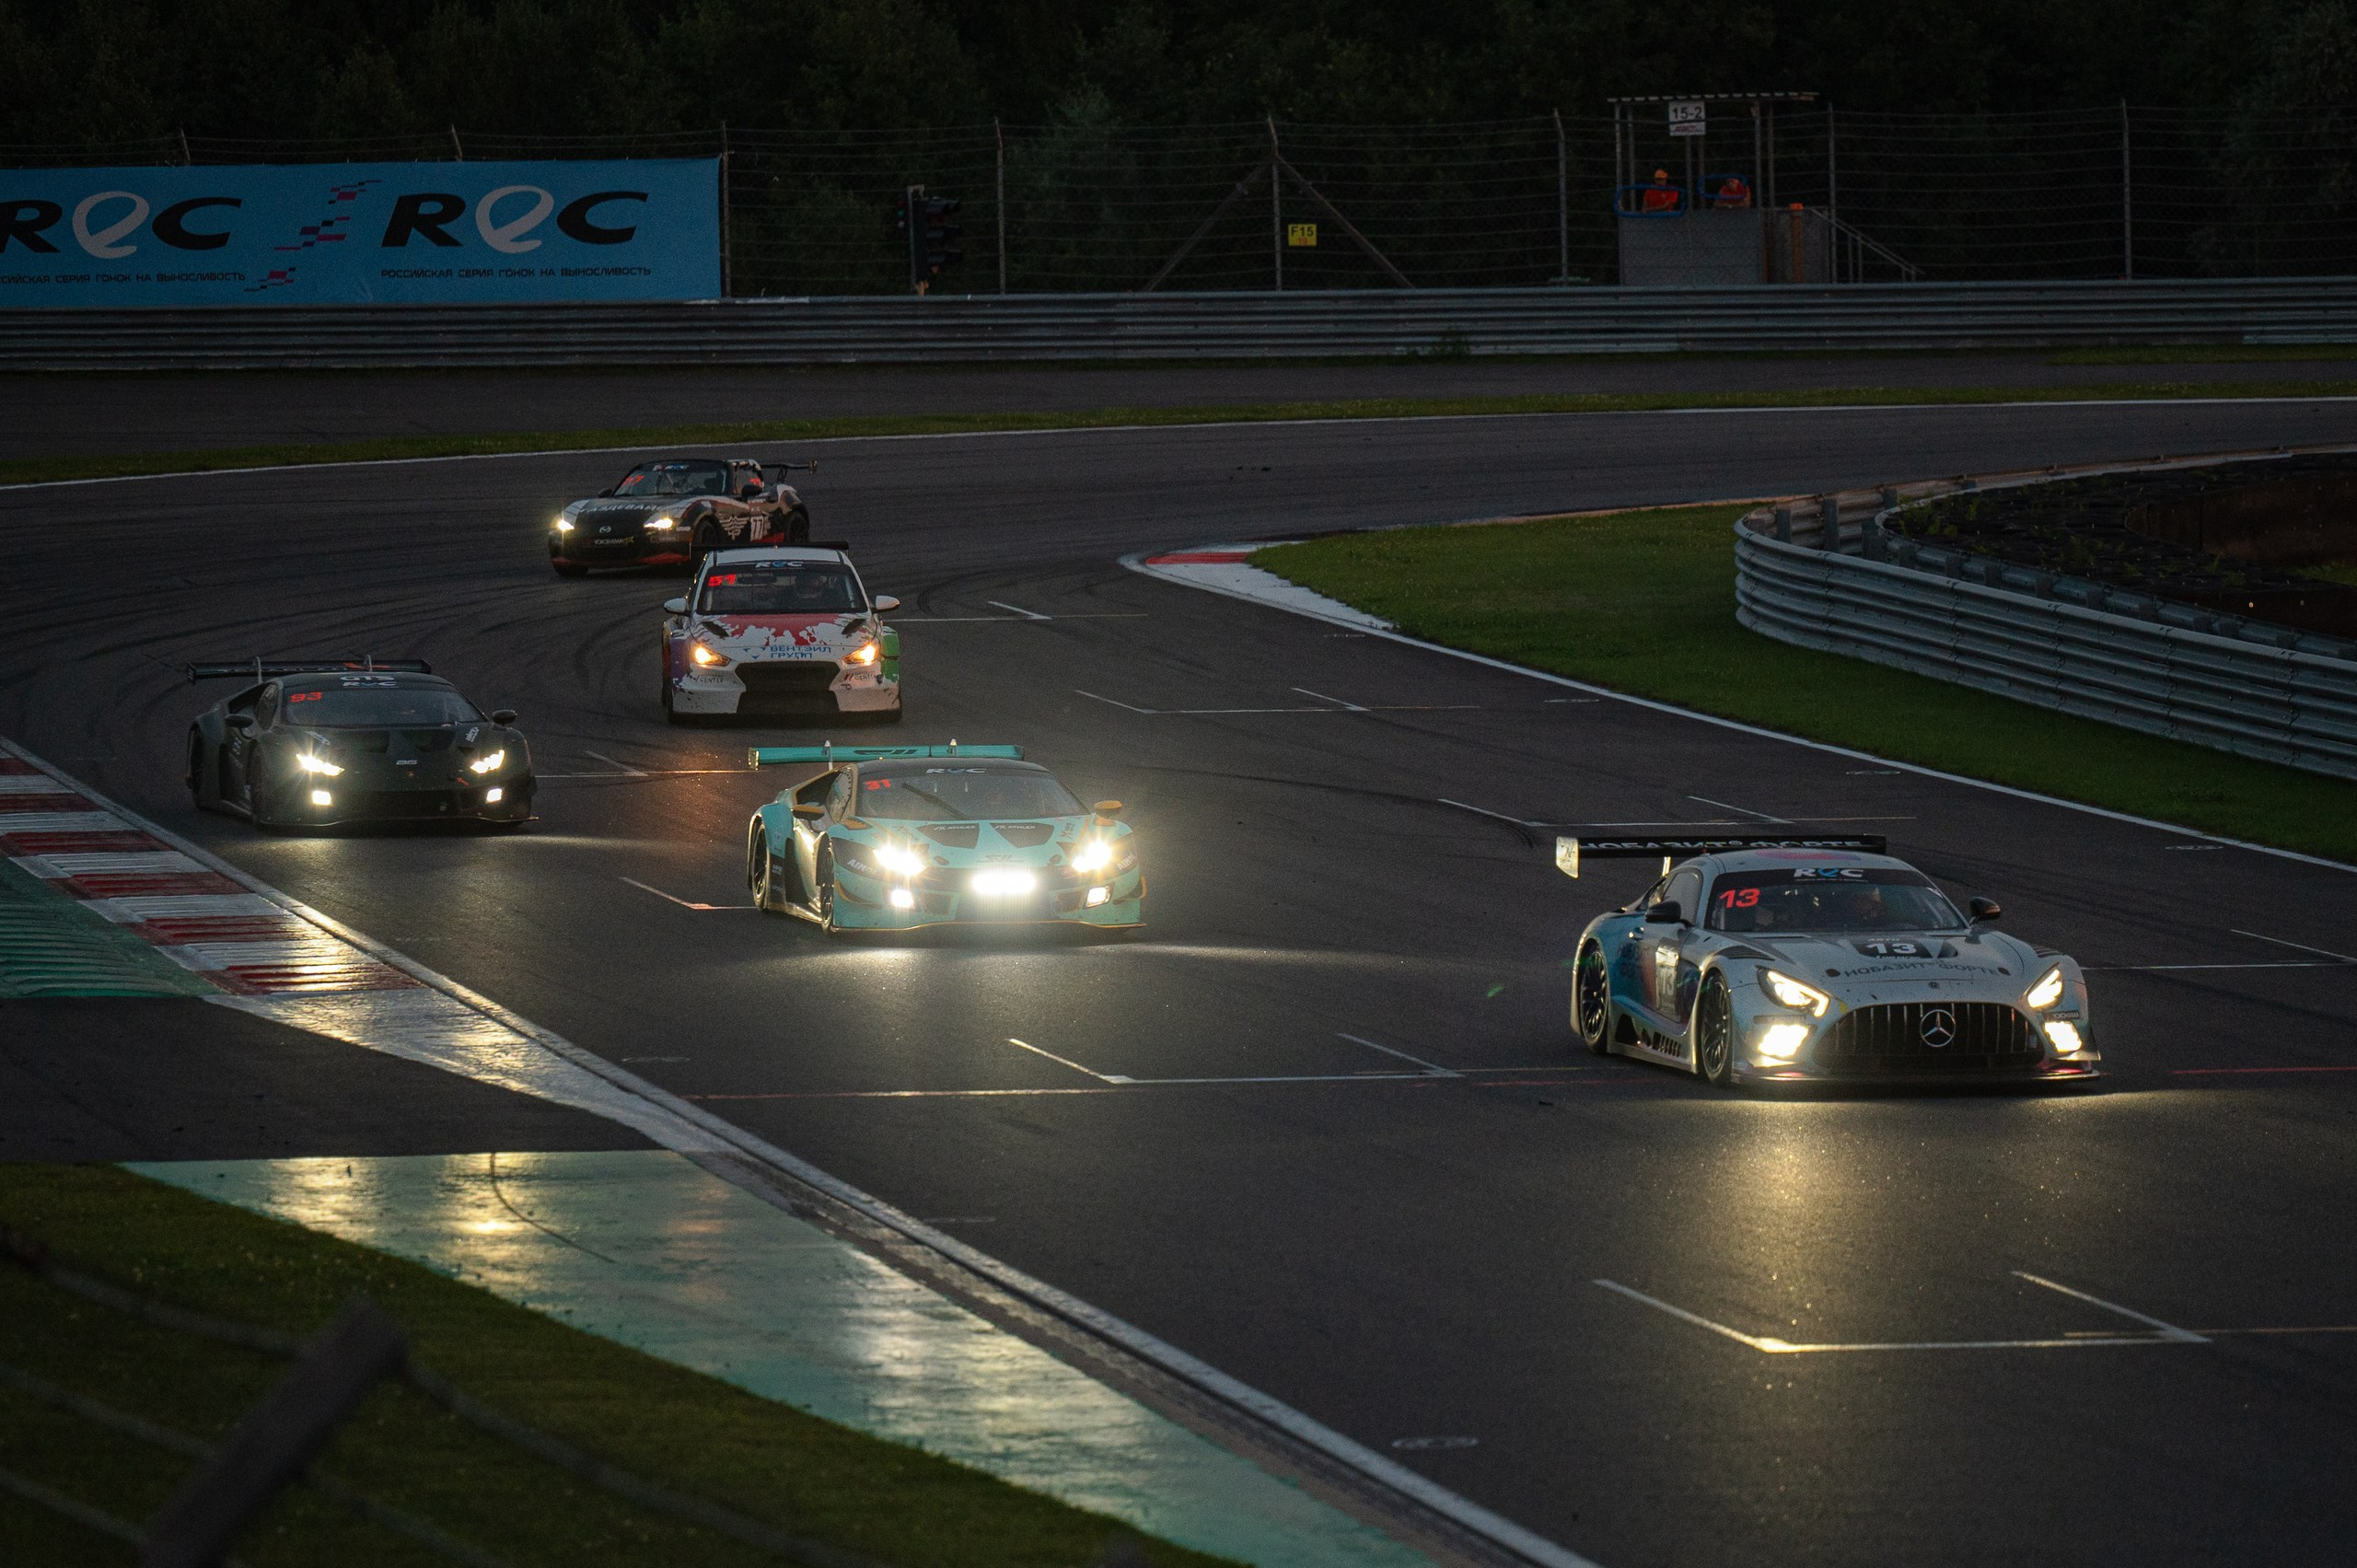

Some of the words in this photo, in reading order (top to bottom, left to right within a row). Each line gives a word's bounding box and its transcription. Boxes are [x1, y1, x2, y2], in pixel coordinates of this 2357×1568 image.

[1672, 106, 1702, 119] 15-2
[1291, 226, 1315, 237] F15
[380, 268, 453, 278] РОССИЙСКАЯ
[458, 268, 494, 277] СЕРИЯ
[498, 267, 535, 277] ГОНОК
[540, 267, 556, 277] НА
[560, 266, 652, 277] ВЫНОСЛИВОСТЬ
[55, 274, 90, 284] СЕРИЯ
[95, 273, 132, 283] ГОНОК
[135, 273, 152, 282] НА
[157, 273, 246, 282] ВЫНОСЛИВОСТЬ
[1719, 888, 1761, 909] 13
[1866, 942, 1917, 955] 13
